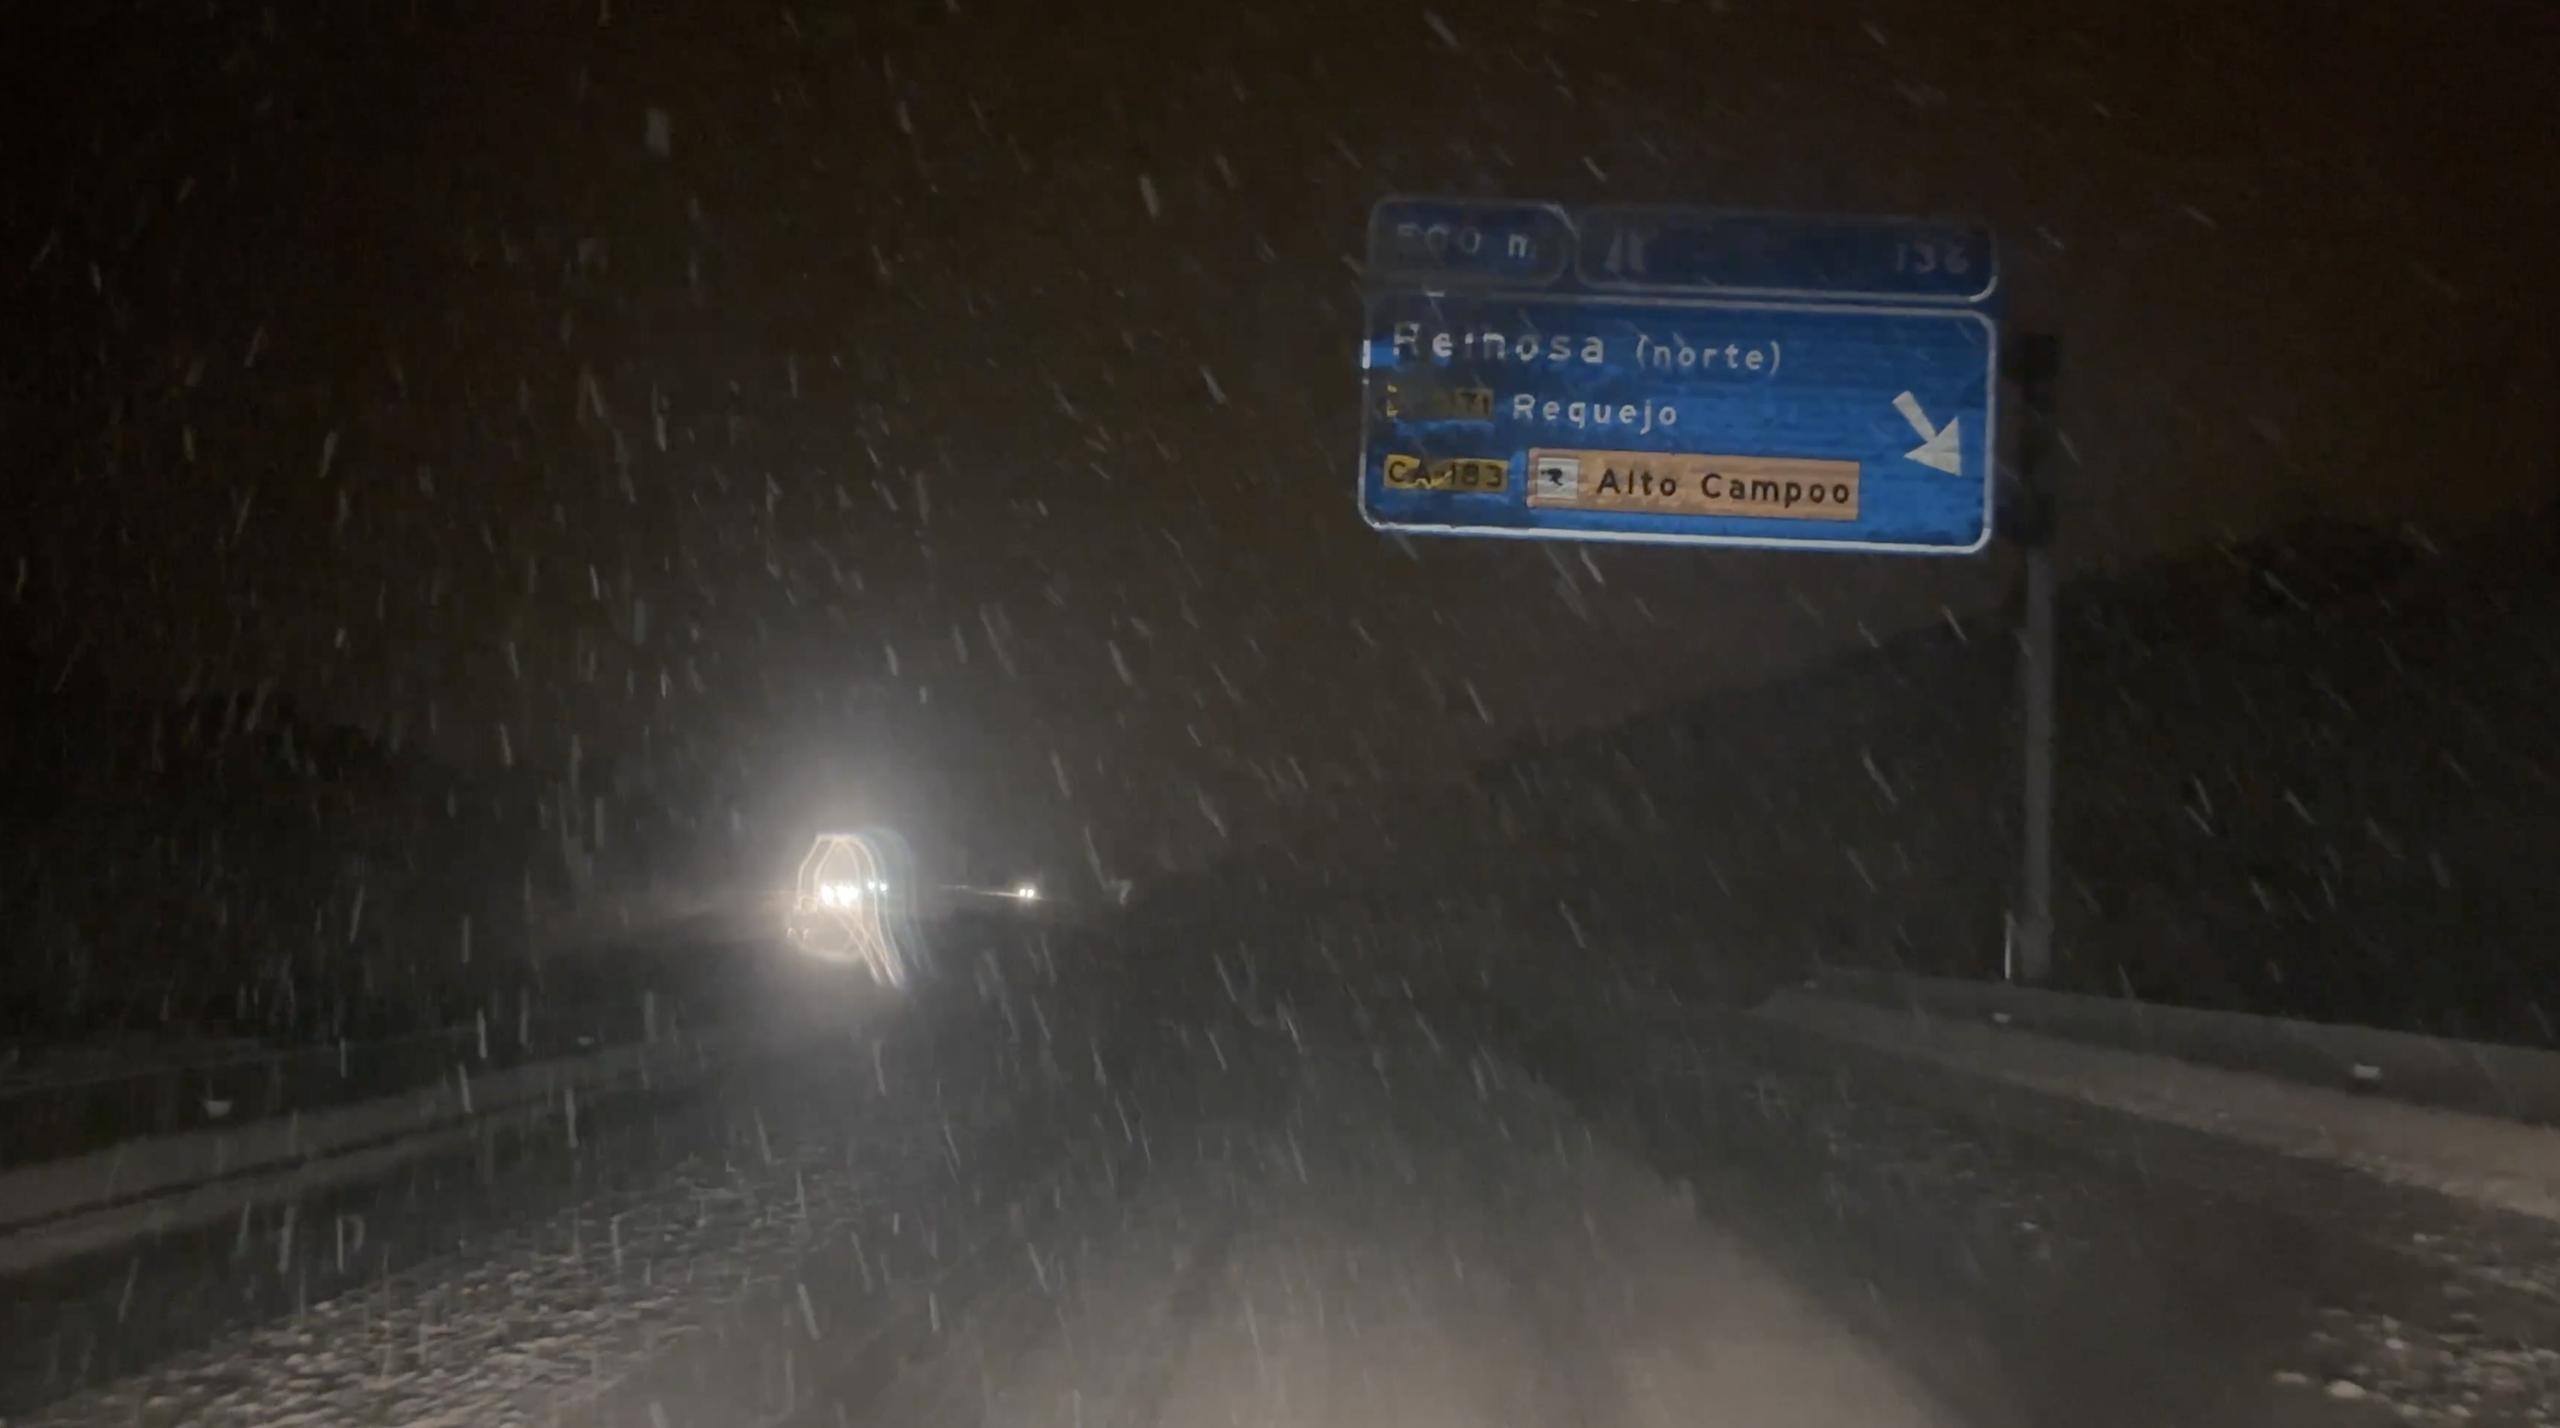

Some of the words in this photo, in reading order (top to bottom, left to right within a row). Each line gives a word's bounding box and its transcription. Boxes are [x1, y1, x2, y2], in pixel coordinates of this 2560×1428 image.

[1393, 322, 1605, 364] Reinosa
[1636, 334, 1781, 375] (norte)
[1513, 393, 1678, 435] Requejo
[1597, 467, 1679, 499] Alto
[1700, 472, 1852, 505] Campoo
